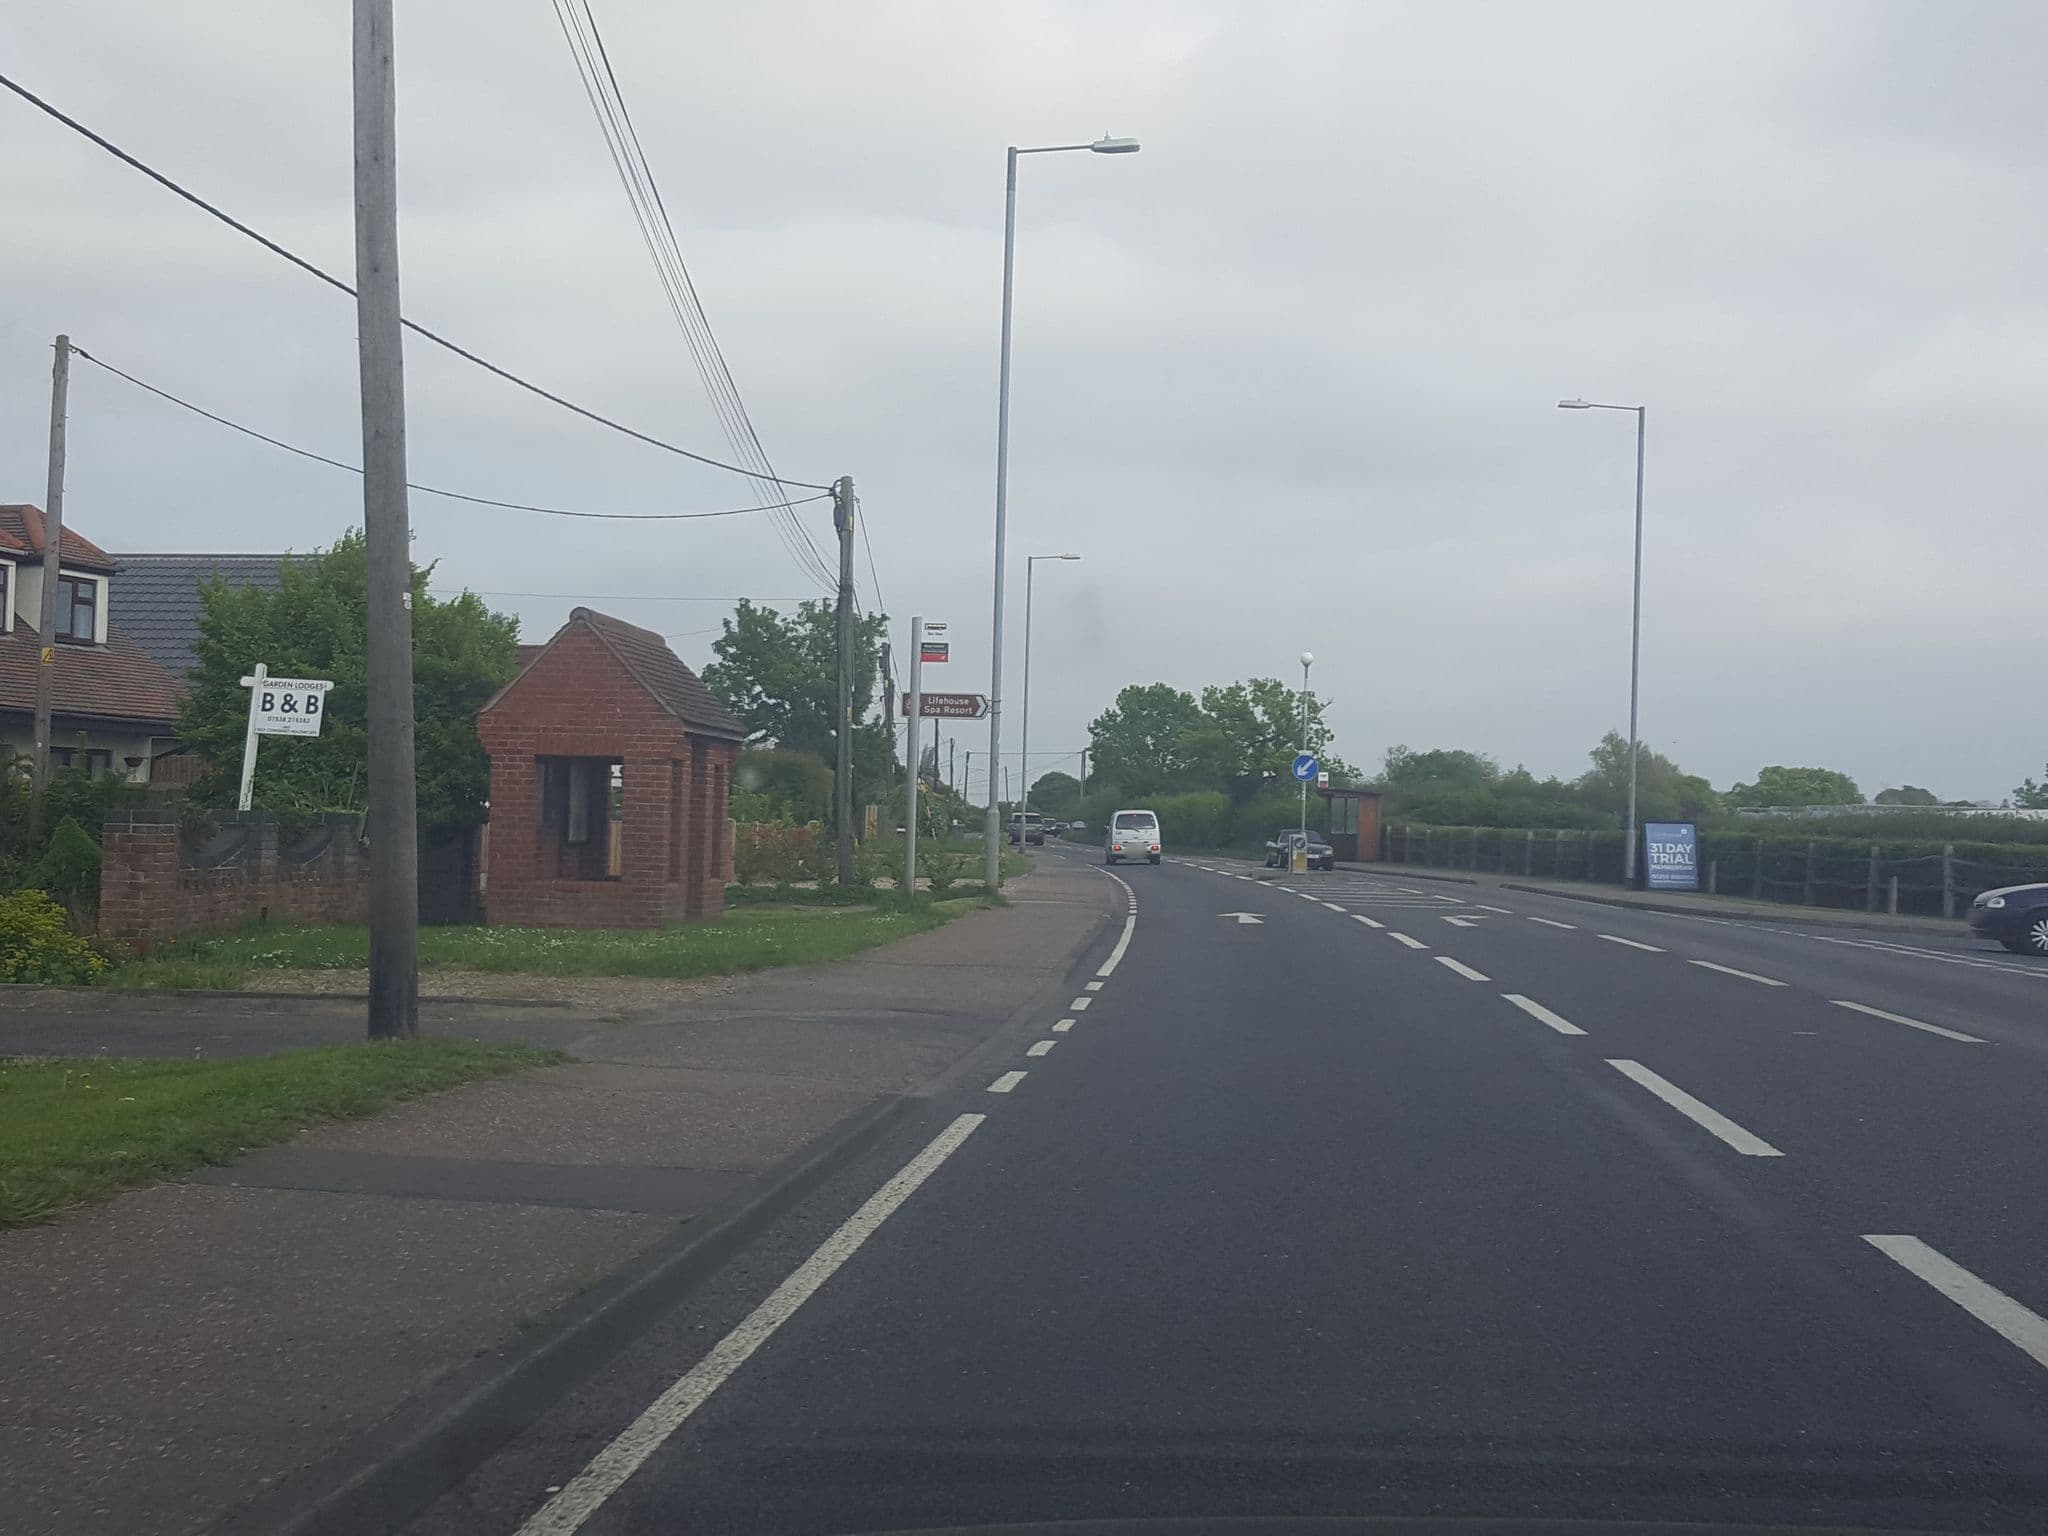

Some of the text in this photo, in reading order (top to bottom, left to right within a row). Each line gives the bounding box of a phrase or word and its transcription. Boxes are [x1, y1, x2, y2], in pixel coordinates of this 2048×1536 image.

[263, 680, 324, 690] GARDEN LODGES
[261, 692, 319, 715] B & B
[928, 696, 970, 705] Lifehouse
[924, 706, 941, 715] Spa
[1650, 843, 1693, 853] 31 DAY
[1651, 853, 1693, 864] TRIAL
